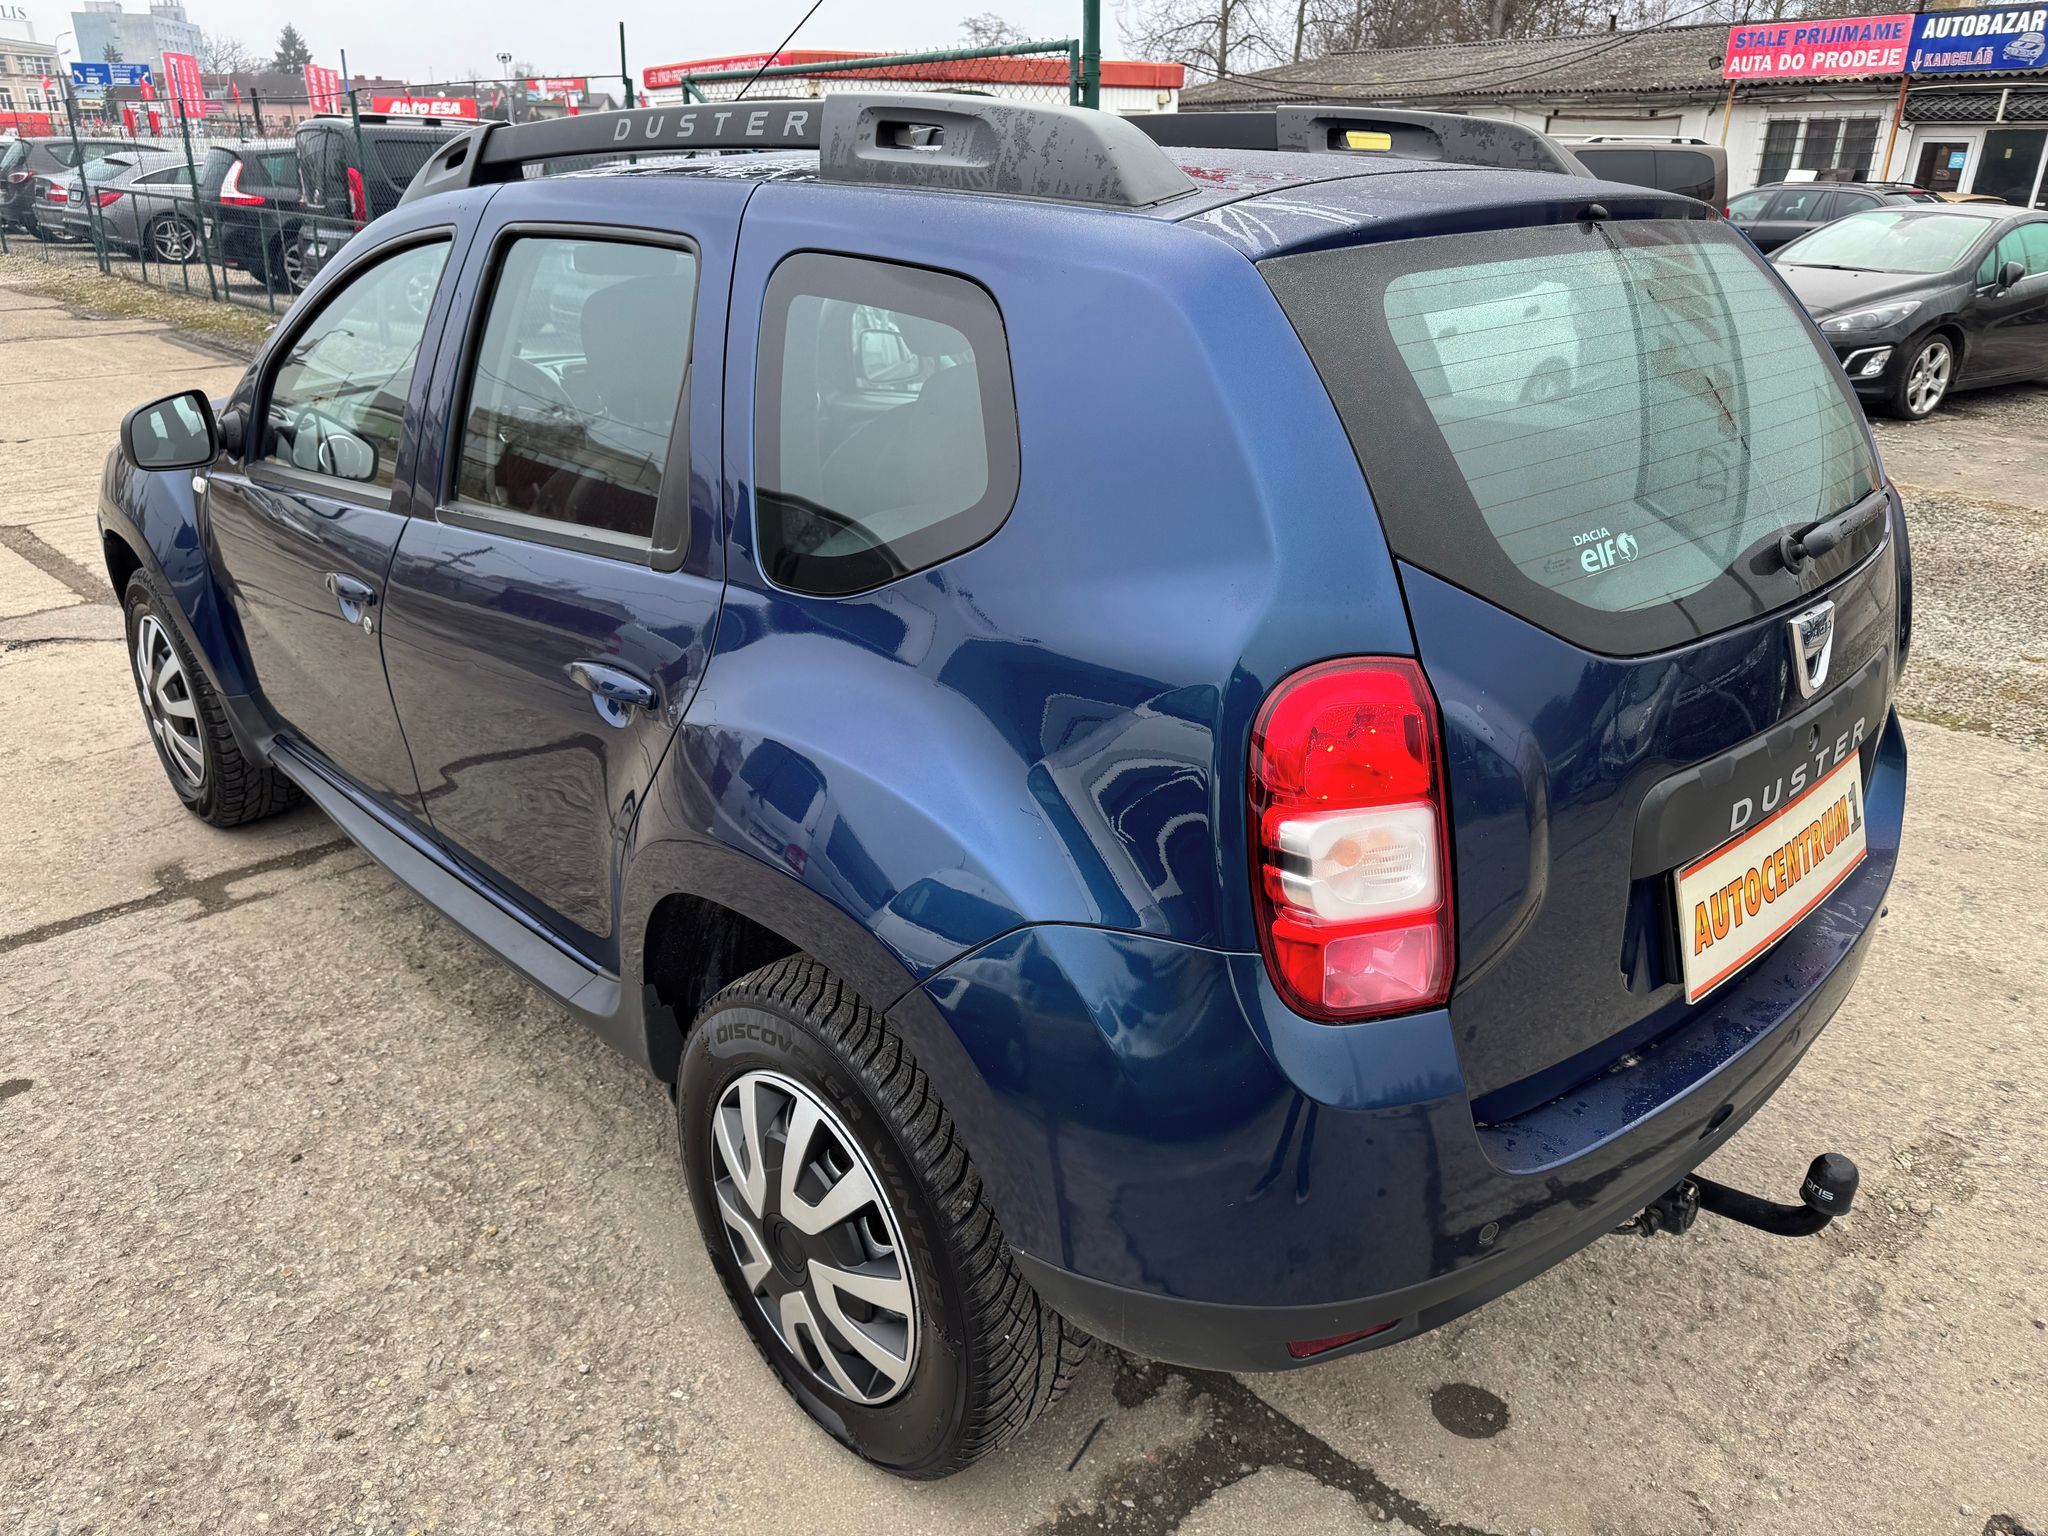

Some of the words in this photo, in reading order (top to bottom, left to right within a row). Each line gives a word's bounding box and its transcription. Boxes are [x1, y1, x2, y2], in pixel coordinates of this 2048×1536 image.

[1921, 9, 2048, 39] AUTOBAZAR
[1728, 54, 1772, 73] AUTA
[1778, 52, 1805, 71] DO
[1811, 47, 1903, 70] PRODEJE
[1923, 46, 1994, 67] KANCELÁŘ
[389, 101, 428, 115] Auto
[430, 101, 462, 115] ESA
[613, 110, 809, 141] DUSTER
[1572, 527, 1611, 546] DACIA
[1580, 538, 1616, 573] elf
[1729, 716, 1865, 833] DUSTER
